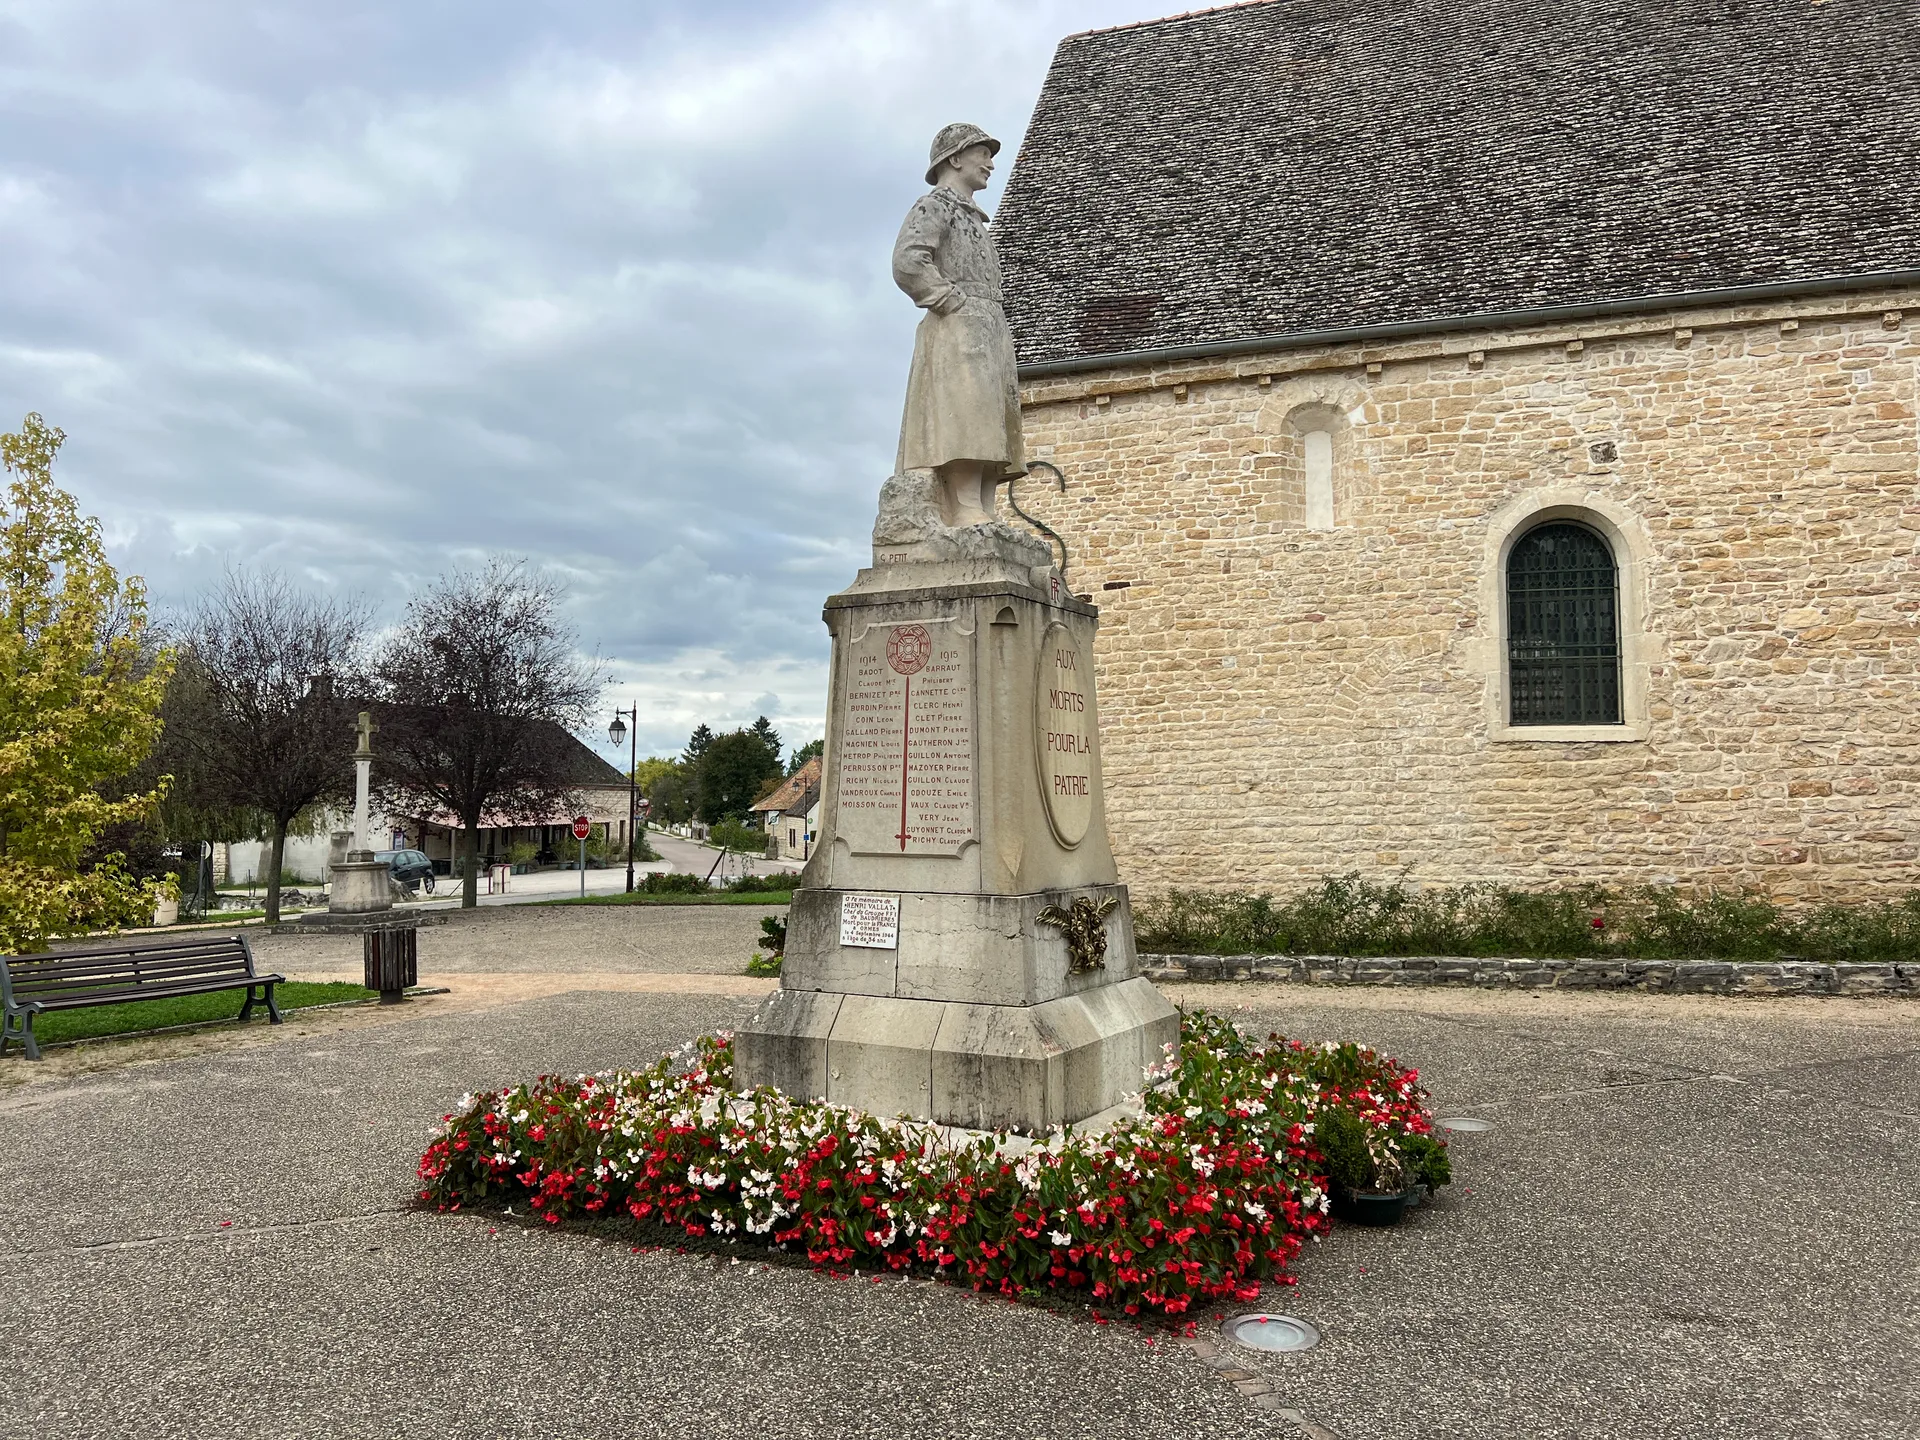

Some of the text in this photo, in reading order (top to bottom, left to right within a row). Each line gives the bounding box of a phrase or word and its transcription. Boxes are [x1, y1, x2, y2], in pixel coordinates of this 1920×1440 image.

[890, 553, 908, 563] PETIT
[860, 656, 876, 666] 1914
[940, 650, 958, 662] 1915
[1055, 648, 1076, 671] AUX
[926, 664, 960, 672] BARRAUT
[910, 688, 948, 696] CANNETTE
[1050, 688, 1084, 712] MORTS
[1048, 732, 1090, 756] POUR LA
[1054, 775, 1088, 797] PATRIE
[574, 824, 588, 832] STOP
